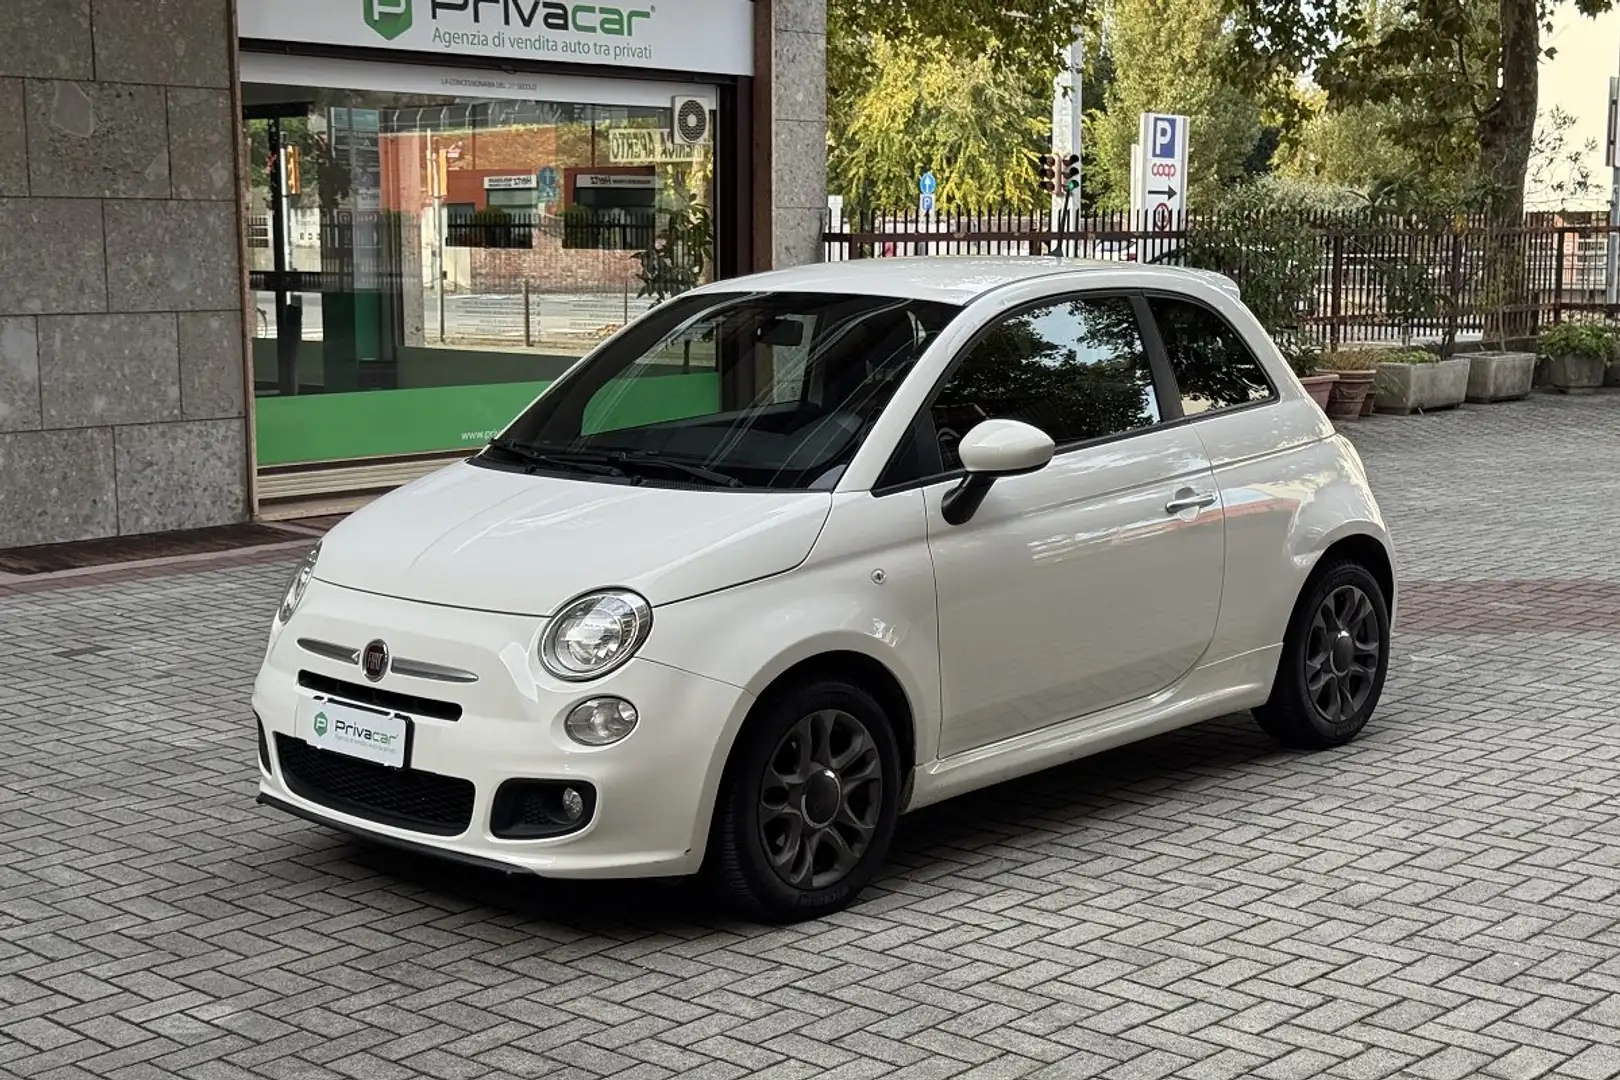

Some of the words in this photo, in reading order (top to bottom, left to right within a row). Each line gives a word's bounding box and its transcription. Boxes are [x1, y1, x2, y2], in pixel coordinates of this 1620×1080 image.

[432, 27, 488, 48] Agenzia
[492, 31, 504, 48] di
[508, 34, 558, 51] vendita
[561, 40, 590, 54] auto
[593, 42, 610, 56] tra
[614, 42, 652, 60] privati
[1156, 121, 1171, 155] P
[1152, 163, 1176, 180] coop
[334, 719, 397, 745] Privacar
